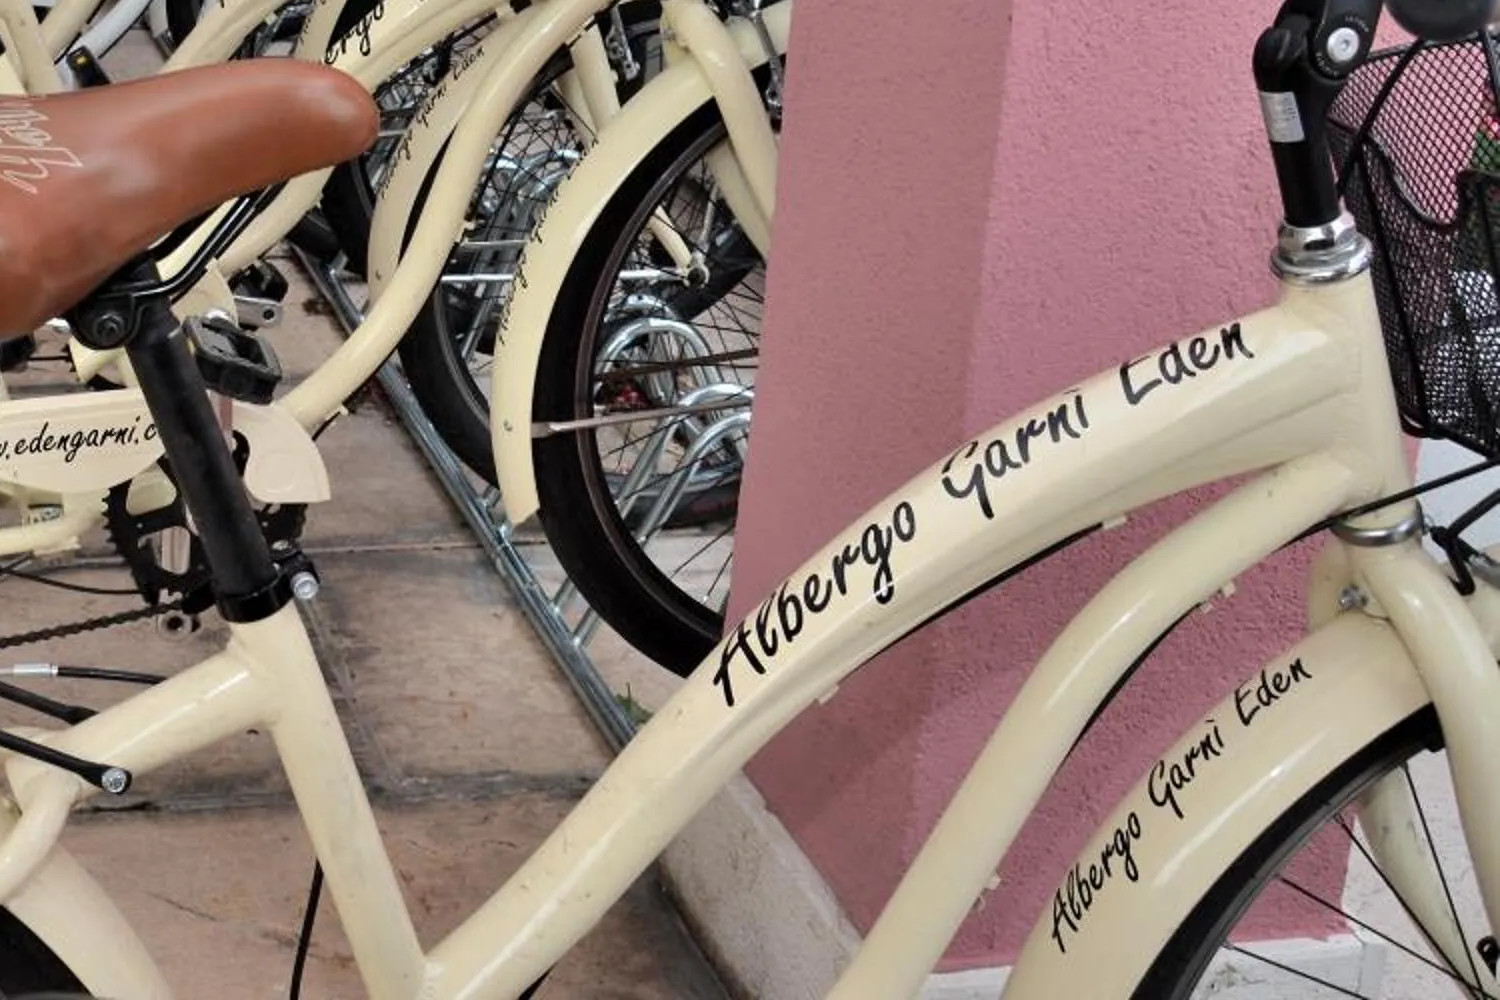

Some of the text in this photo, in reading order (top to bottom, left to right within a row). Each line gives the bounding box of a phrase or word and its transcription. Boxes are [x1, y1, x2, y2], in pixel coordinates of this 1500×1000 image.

[712, 501, 916, 708] Albergo
[1118, 321, 1255, 406] Eden
[1051, 811, 1142, 954] Albergo
[1234, 657, 1313, 728] Eden
